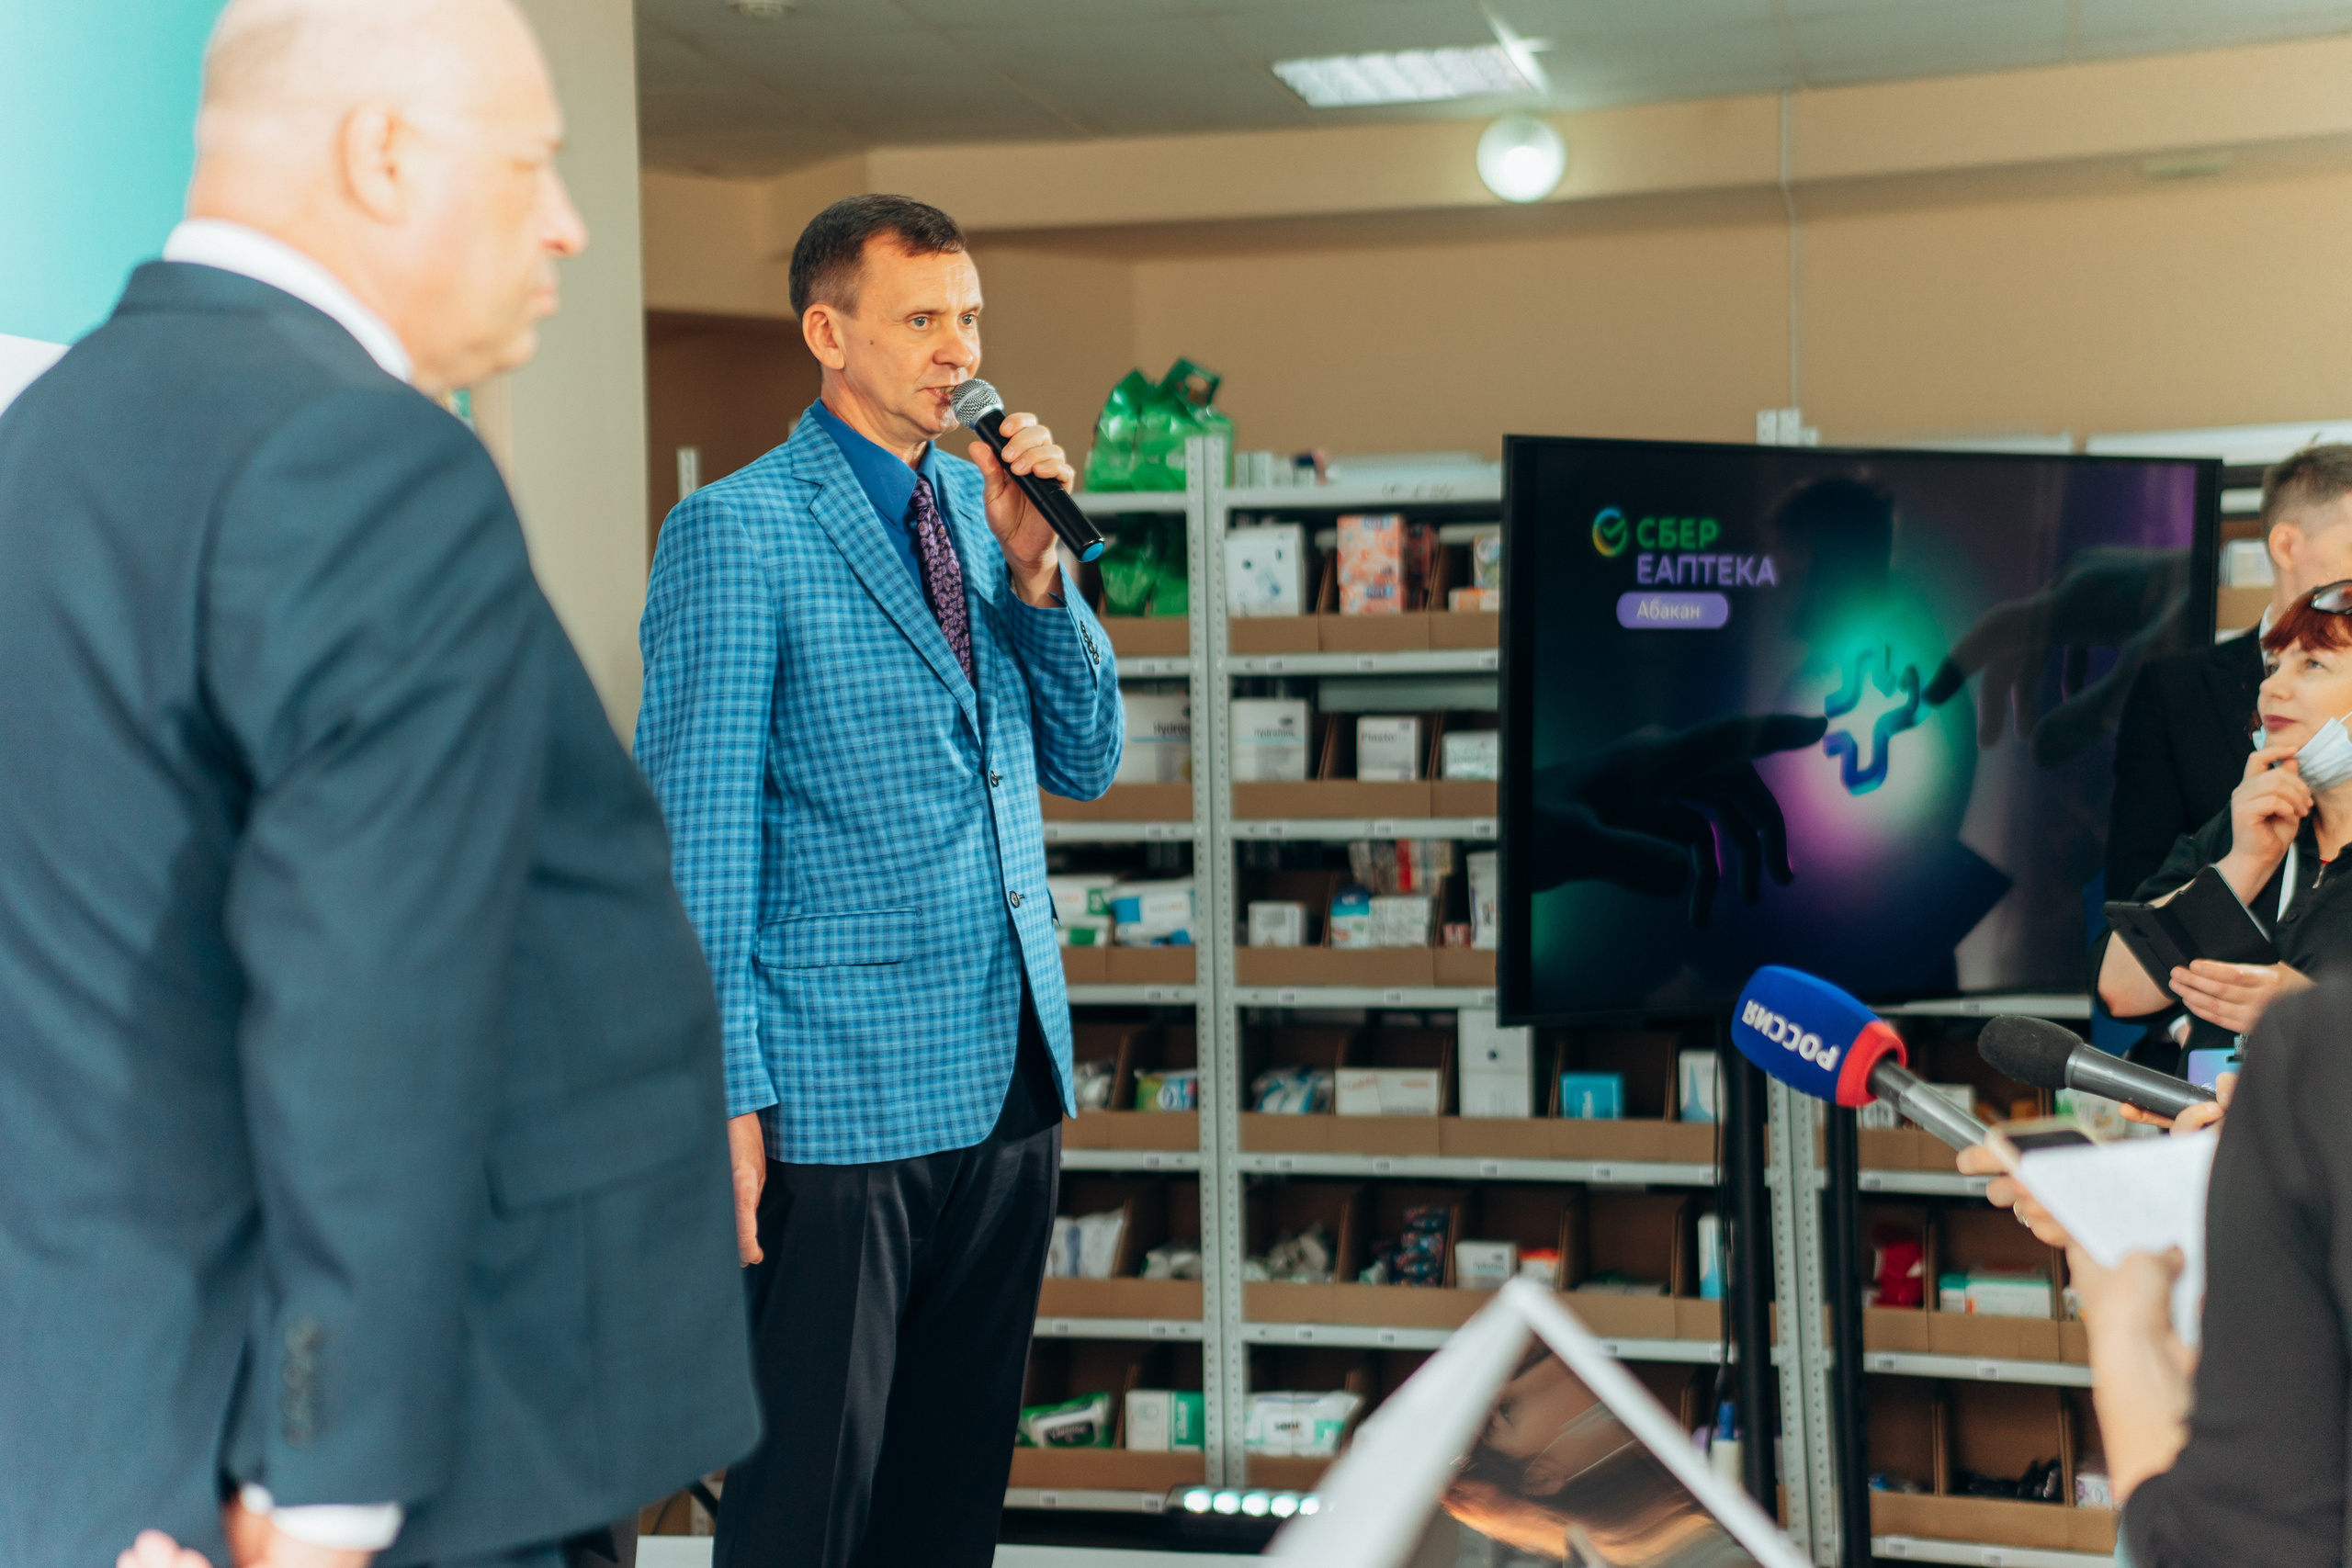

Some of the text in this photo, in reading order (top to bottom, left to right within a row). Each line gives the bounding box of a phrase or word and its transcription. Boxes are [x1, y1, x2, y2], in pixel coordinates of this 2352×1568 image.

[1636, 517, 1717, 549] СБЕР
[1637, 554, 1776, 586] ЕАПТЕКА
[1636, 599, 1701, 620] Абакан
[1742, 998, 1841, 1073] РОССИЯ
